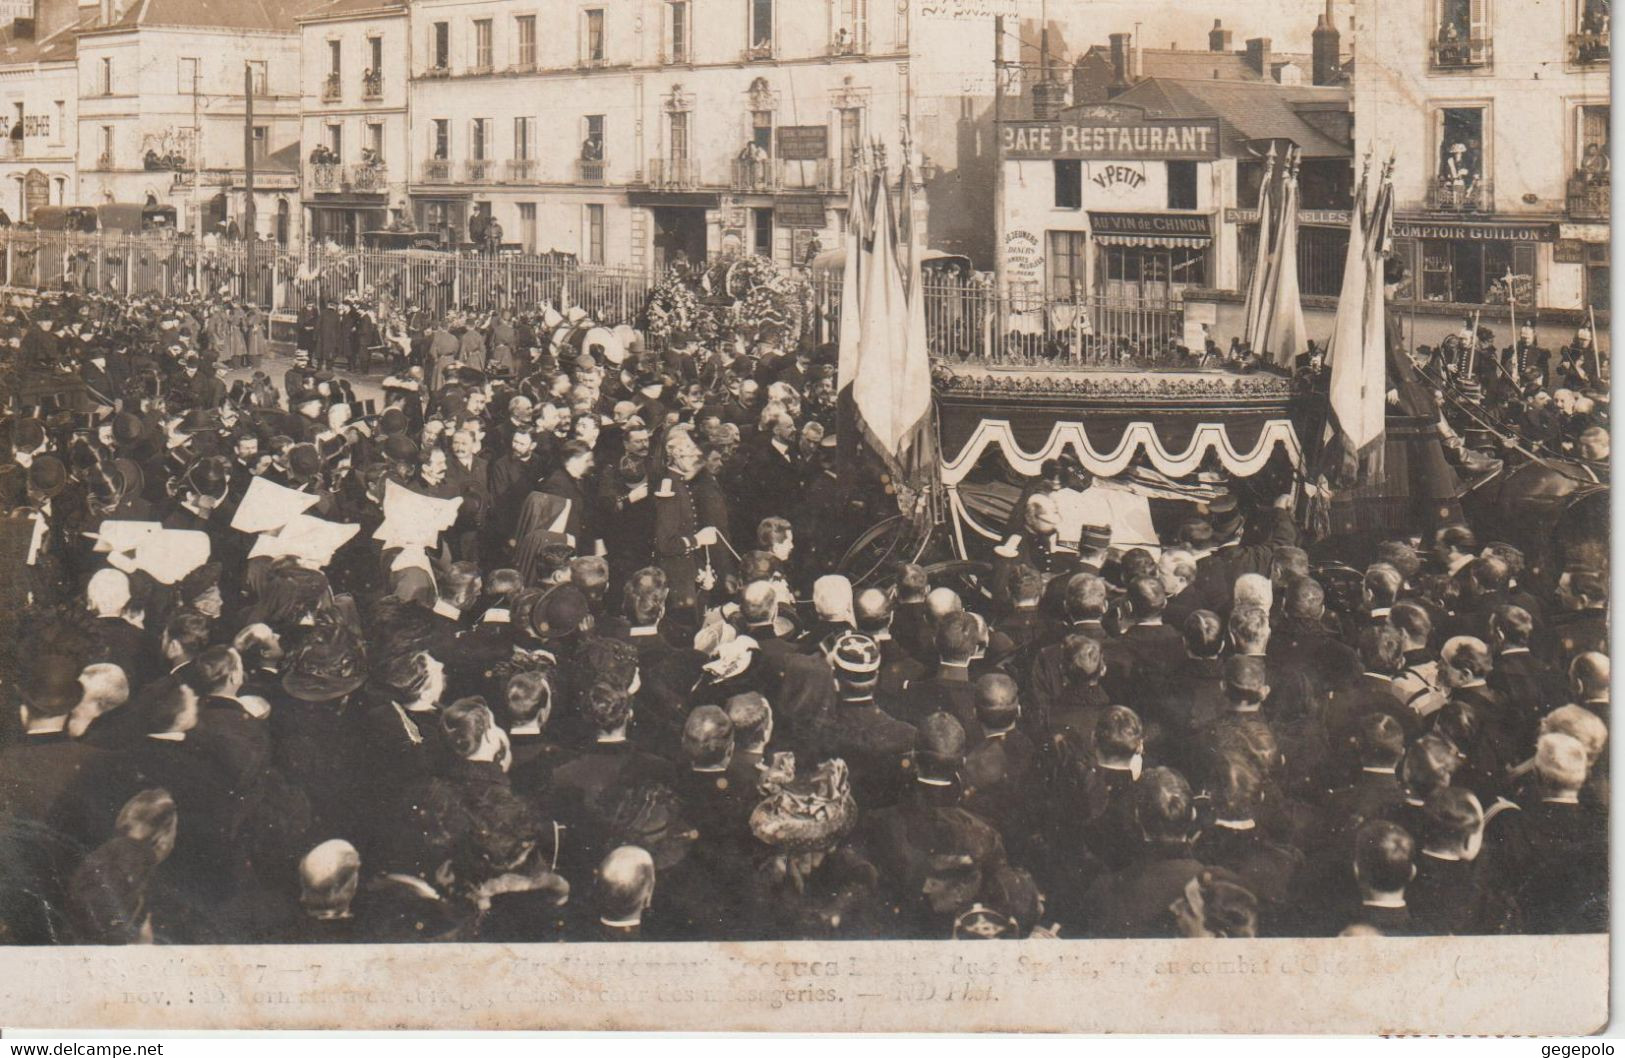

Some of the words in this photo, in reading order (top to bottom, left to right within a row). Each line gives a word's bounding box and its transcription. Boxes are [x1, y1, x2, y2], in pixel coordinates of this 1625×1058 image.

[1093, 217, 1109, 229] AU
[1112, 217, 1136, 230] VIN
[1153, 217, 1206, 232] CHINON
[1391, 224, 1465, 240] COMPTOIR
[1469, 225, 1540, 241] GUILLON
